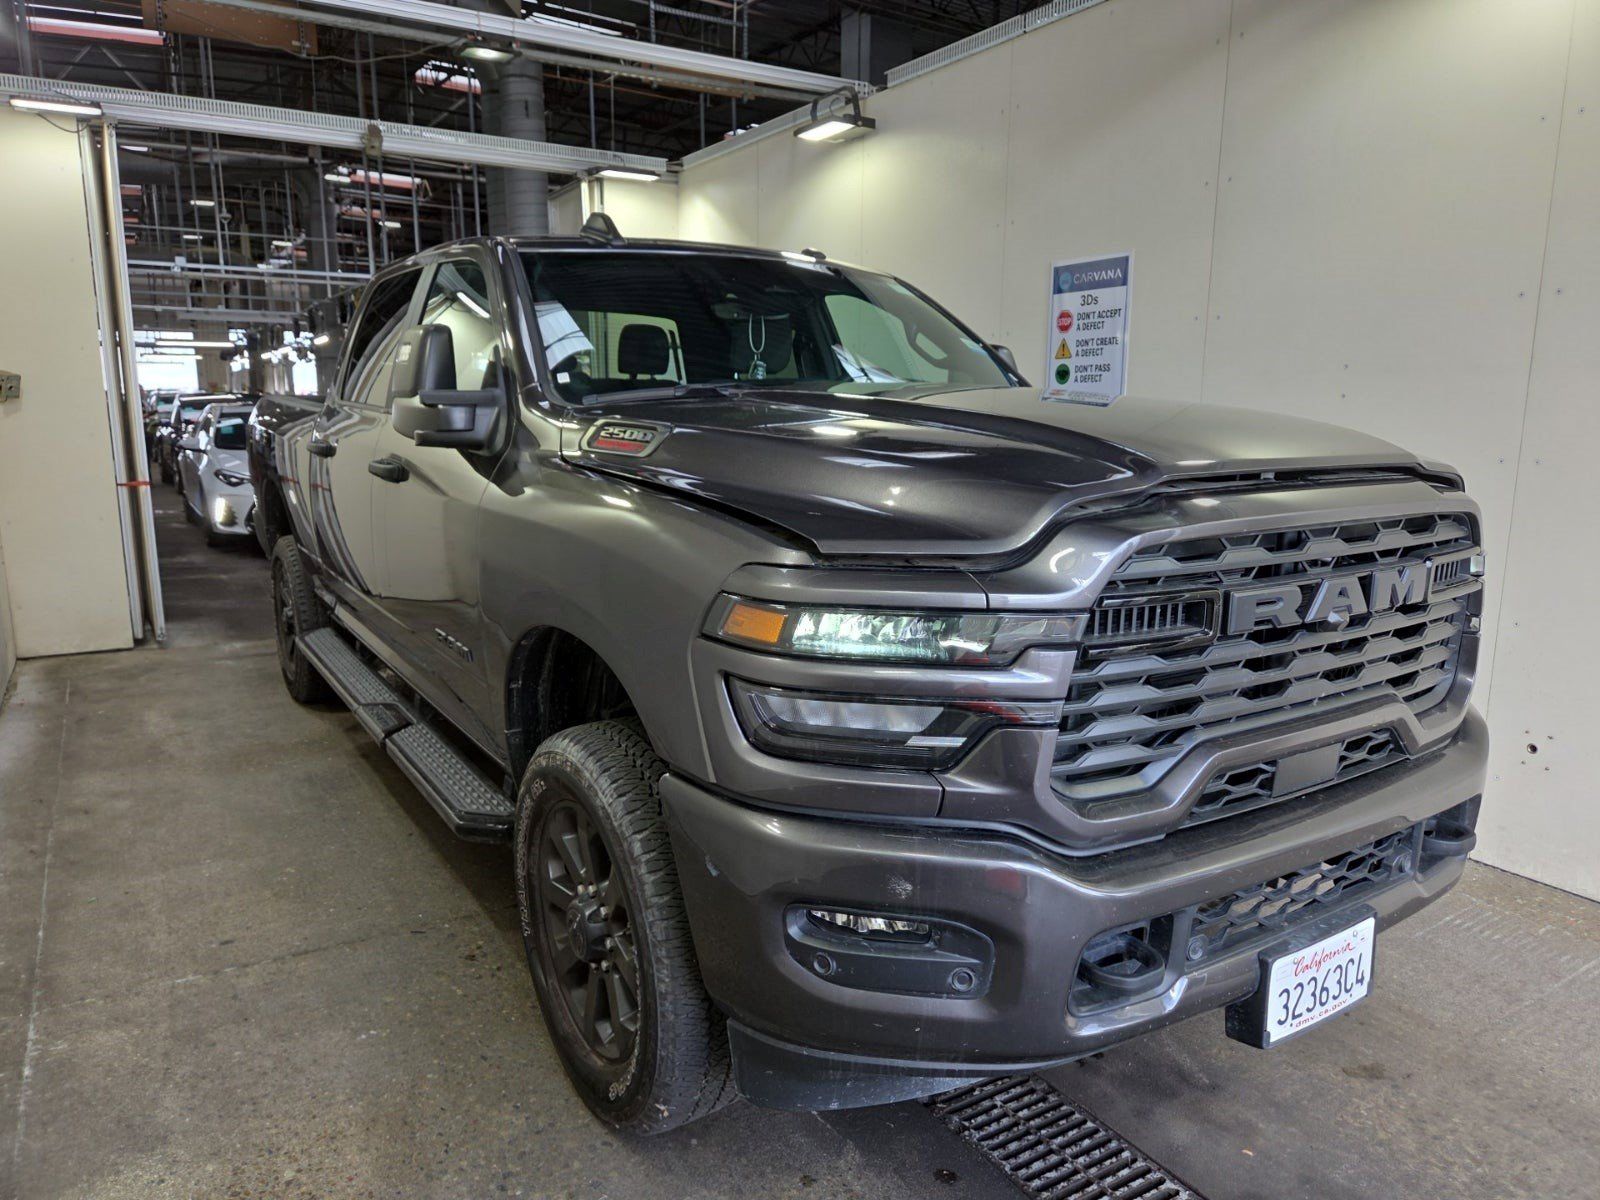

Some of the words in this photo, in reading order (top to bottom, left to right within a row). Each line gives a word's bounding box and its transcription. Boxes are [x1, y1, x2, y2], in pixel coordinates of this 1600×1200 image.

[1073, 268, 1122, 284] CARVANA
[1080, 294, 1099, 306] 3Ds
[1076, 312, 1096, 321] DON'T
[1097, 308, 1122, 320] ACCEPT
[1076, 322, 1081, 331] A
[1082, 321, 1105, 331] DEFECT
[1075, 338, 1095, 347] DON'T
[1095, 337, 1119, 346] CREATE
[1075, 349, 1080, 357] A
[1081, 348, 1104, 357] DEFECT
[1074, 365, 1094, 373] DON'T
[1094, 363, 1111, 373] PASS
[1074, 375, 1079, 383] A
[1079, 374, 1103, 383] DEFECT
[600, 426, 654, 442] 2500
[1229, 563, 1429, 635] RAM
[1294, 940, 1356, 977] California
[1277, 952, 1365, 1026] 32363C4
[1295, 999, 1348, 1028] dmv.ca.gov
